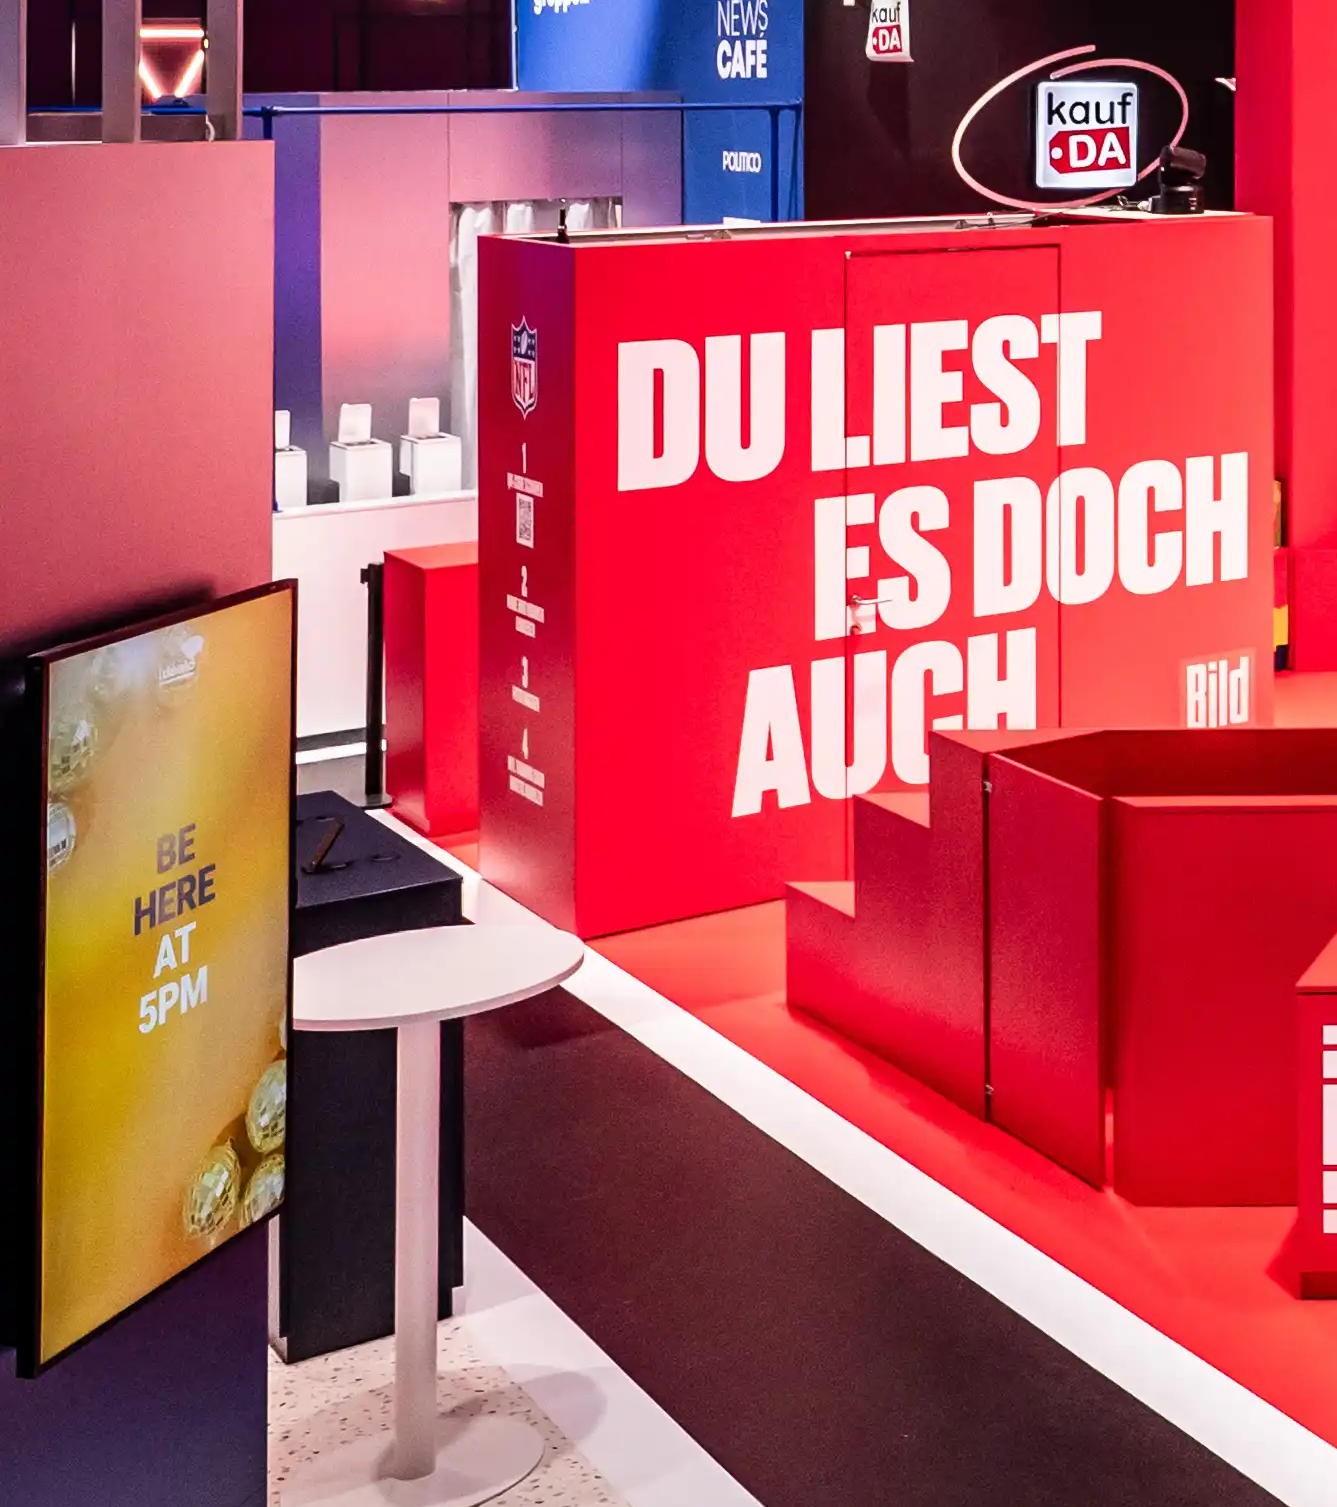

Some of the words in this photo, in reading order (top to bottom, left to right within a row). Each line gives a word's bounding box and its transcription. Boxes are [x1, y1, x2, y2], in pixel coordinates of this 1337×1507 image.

[871, 1, 901, 24] kauf
[716, 32, 768, 80] CAFÉ
[877, 27, 901, 52] DA
[1047, 91, 1134, 126] kauf
[722, 150, 762, 173] POLITICO
[1068, 131, 1127, 169] DA
[513, 359, 535, 403] NFL
[617, 330, 786, 492] DU
[811, 310, 1102, 472] LIEST
[520, 441, 527, 474] 1
[813, 485, 952, 642] ES
[973, 451, 1249, 618] DOCH
[520, 565, 528, 598] 2
[521, 656, 529, 689] 3
[1186, 656, 1250, 728] Bild
[730, 627, 1037, 818] AUCH
[157, 822, 196, 874] BE
[134, 863, 217, 935] HERE
[152, 920, 197, 979] AT
[138, 965, 209, 1034] 5PM
